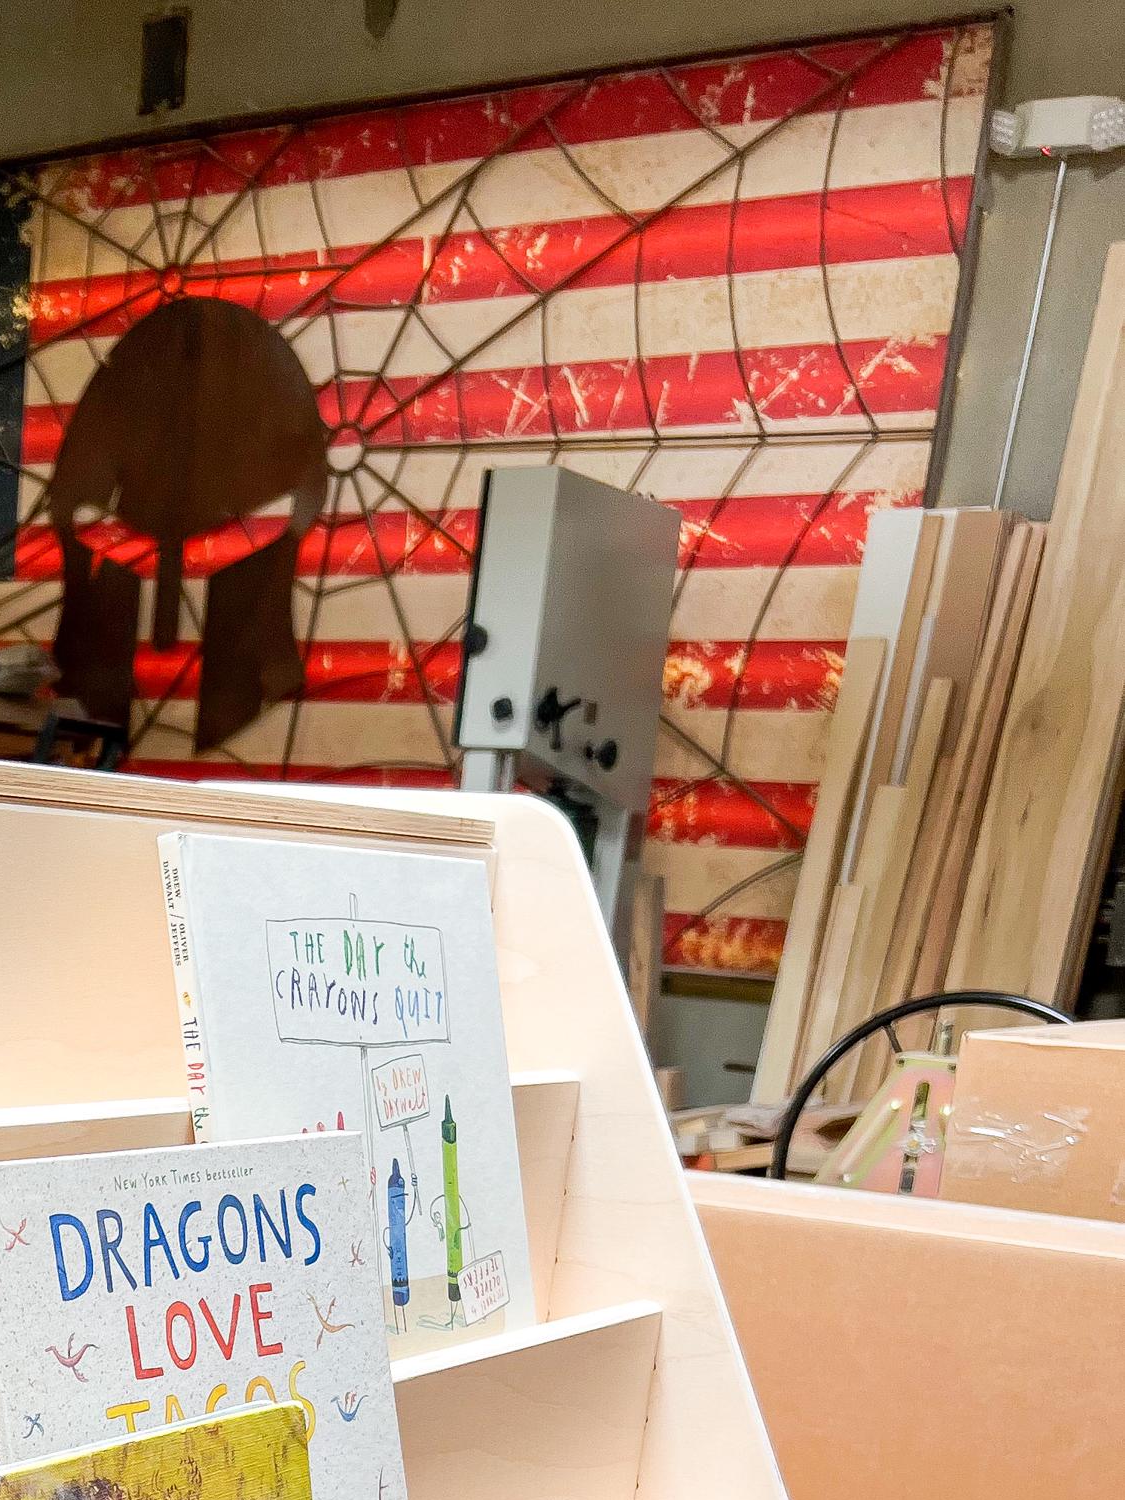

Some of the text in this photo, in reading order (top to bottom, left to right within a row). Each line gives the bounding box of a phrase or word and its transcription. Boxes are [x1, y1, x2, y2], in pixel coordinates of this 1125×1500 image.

[163, 860, 181, 966] DAYWALT JEFFERS
[172, 868, 181, 898] DREW
[179, 923, 189, 961] OLIVER
[289, 929, 427, 981] THE DAY the
[275, 967, 443, 1039] CRAYONS QUIT
[183, 1017, 209, 1130] THE DAY the
[392, 1067, 421, 1091] DREW
[206, 1167, 254, 1182] bestseller
[48, 1184, 321, 1302] DRAGONS
[124, 1282, 284, 1381] LOVE
